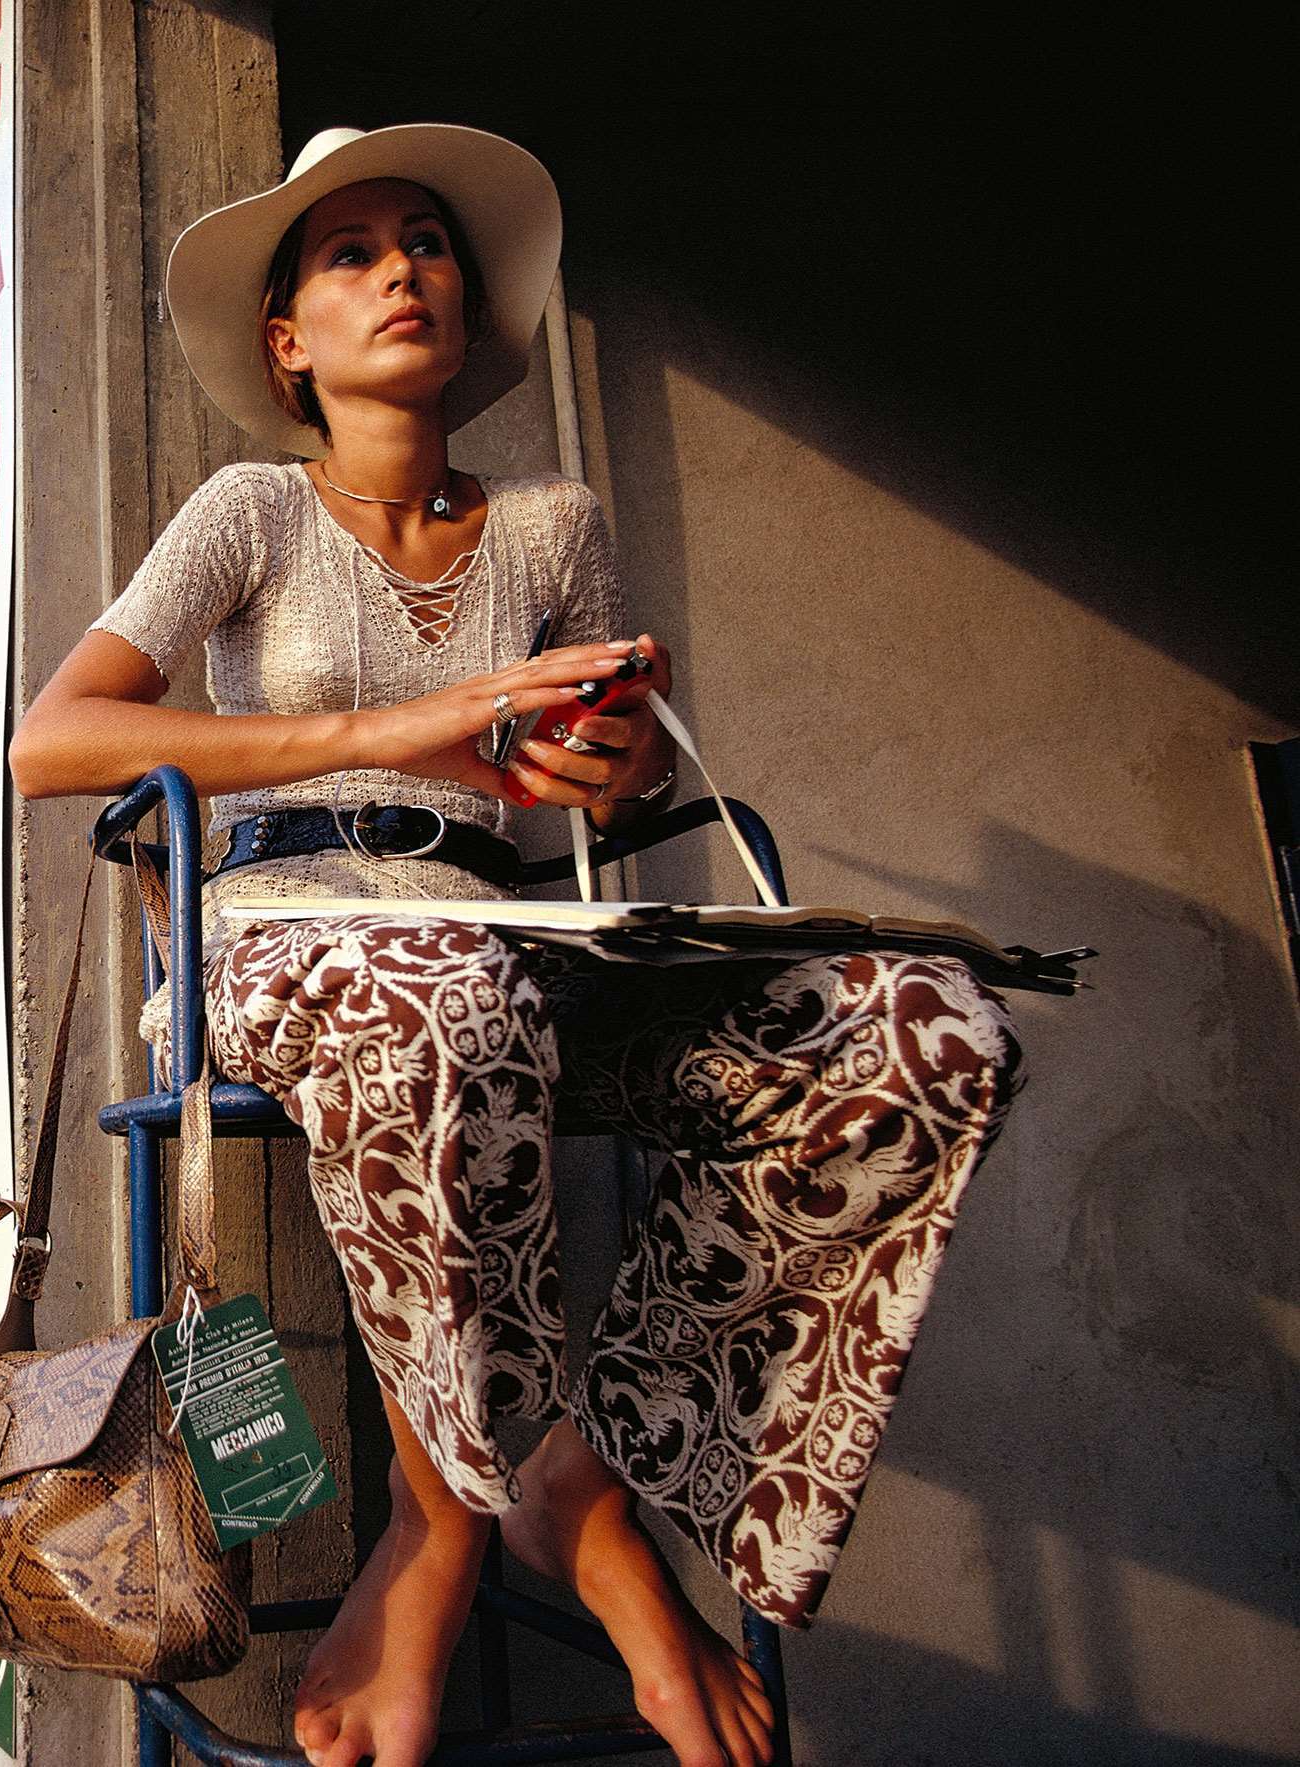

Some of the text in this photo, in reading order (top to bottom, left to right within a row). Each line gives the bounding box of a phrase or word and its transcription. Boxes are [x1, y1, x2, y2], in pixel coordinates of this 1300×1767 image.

[198, 1371, 224, 1389] PREMIO
[224, 1359, 252, 1377] D'ITALIA
[253, 1352, 269, 1365] 1970
[210, 1411, 286, 1461] MECCANICO
[300, 1471, 325, 1505] CONTROLLO
[221, 1519, 258, 1528] CONTROLLO
